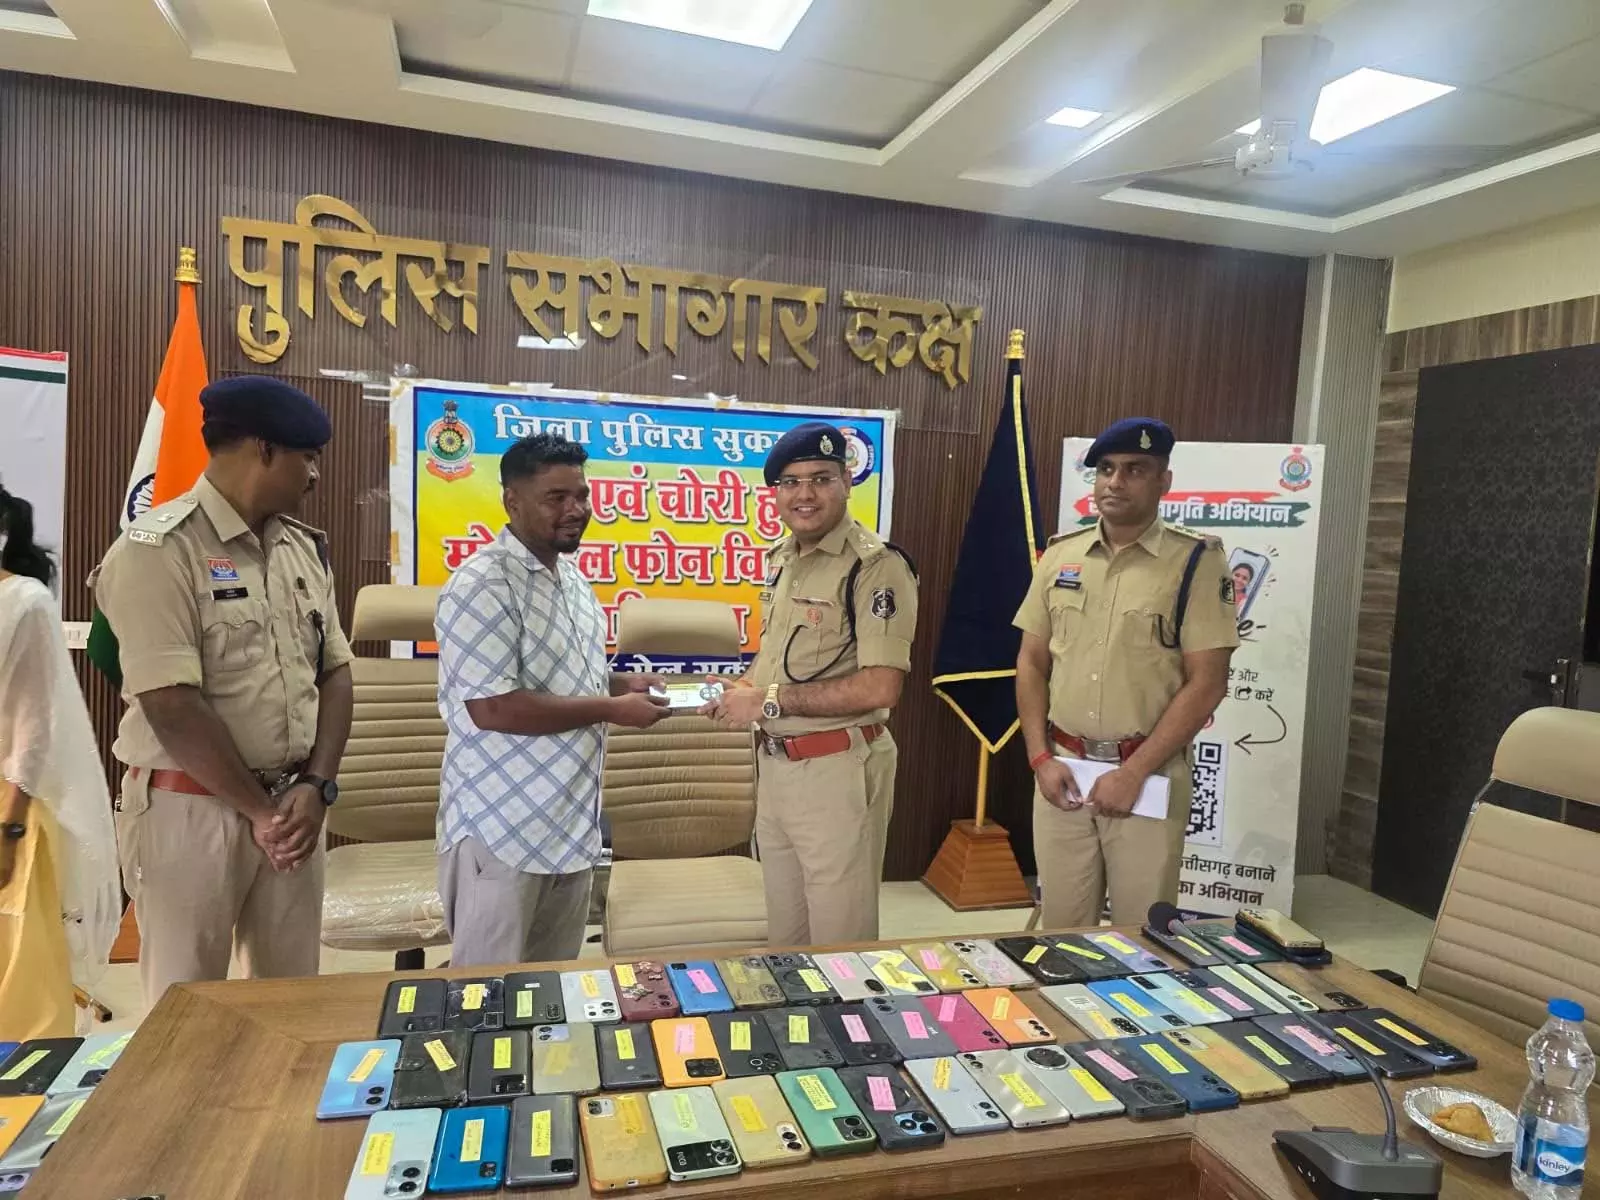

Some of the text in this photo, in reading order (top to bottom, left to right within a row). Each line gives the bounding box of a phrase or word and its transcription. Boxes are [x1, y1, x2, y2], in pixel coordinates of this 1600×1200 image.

[222, 194, 983, 389] पुलिस सभागार कक्ष
[601, 413, 704, 456] पुलिस
[712, 427, 783, 462] सुक
[657, 469, 746, 521] चोरी
[1209, 499, 1292, 524] अभियान
[625, 531, 714, 583] फोन
[1198, 881, 1264, 906] अभियान
[1235, 864, 1277, 883] बनाने
